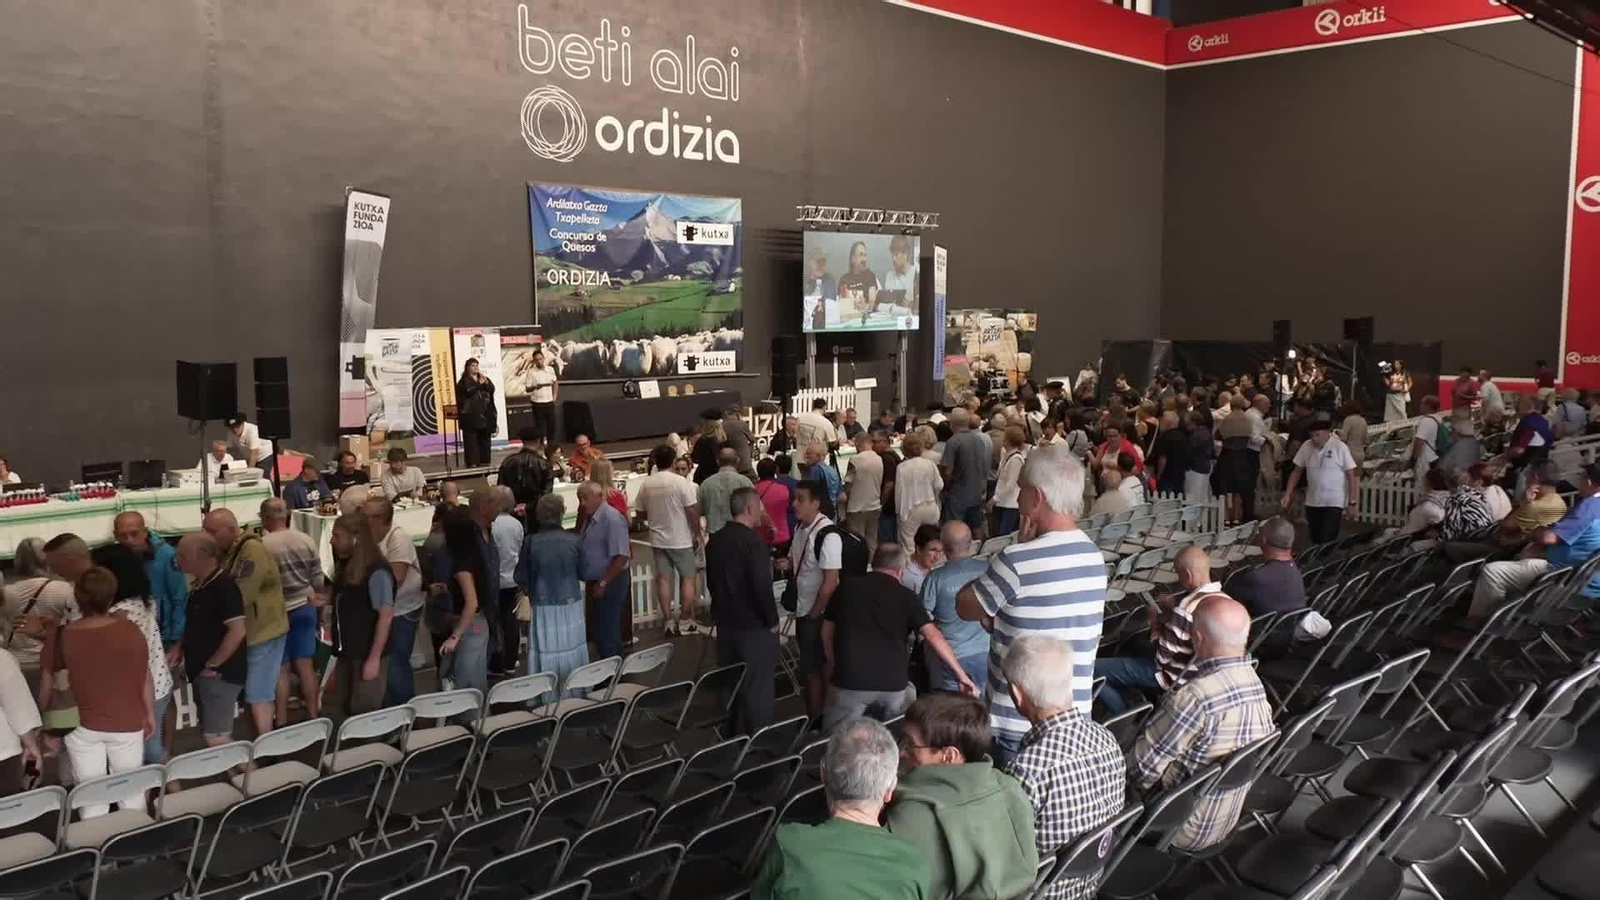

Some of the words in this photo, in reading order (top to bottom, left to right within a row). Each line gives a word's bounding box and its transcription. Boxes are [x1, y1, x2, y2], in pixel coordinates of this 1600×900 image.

[518, 4, 631, 86] beti
[650, 34, 739, 102] alai
[595, 107, 740, 164] ordizia
[354, 201, 384, 214] KUTXA
[546, 197, 583, 211] Ardilatxa
[584, 200, 608, 212] Gazta
[353, 210, 384, 223] FUNDA
[555, 211, 600, 226] Txapelketa
[353, 219, 374, 230] ZIOA
[549, 228, 594, 241] Concurso
[596, 231, 607, 242] de
[701, 227, 729, 239] kutxa
[562, 240, 596, 253] Quesos
[547, 268, 612, 286] ORDIZIA
[703, 356, 731, 367] kutxa
